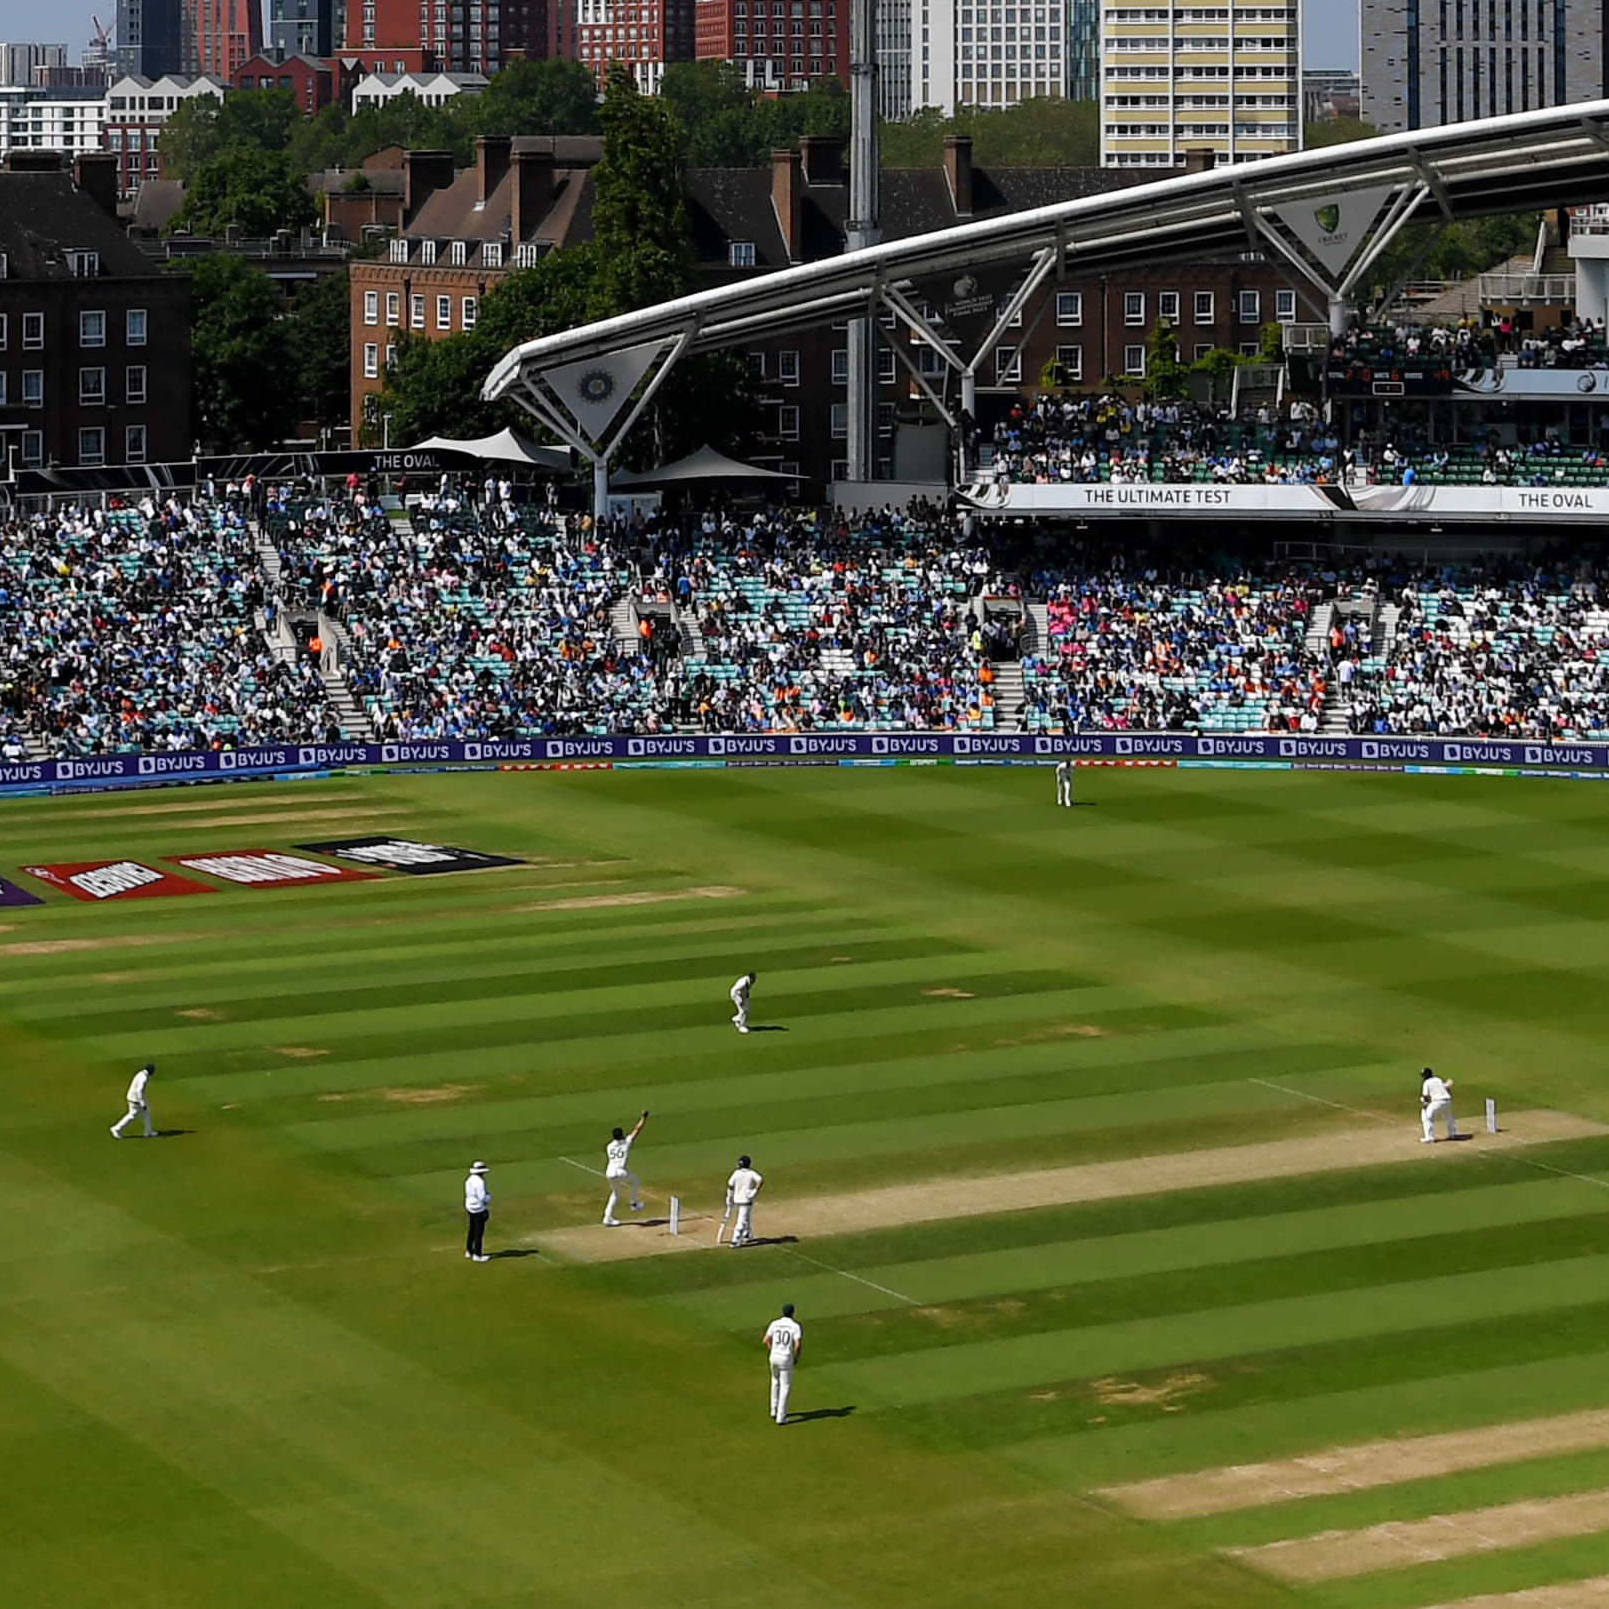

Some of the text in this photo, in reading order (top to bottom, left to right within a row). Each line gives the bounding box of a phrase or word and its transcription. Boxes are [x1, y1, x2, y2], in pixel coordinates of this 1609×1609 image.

[1391, 370, 1399, 380] 6
[374, 455, 440, 469] THE OVAL
[1085, 490, 1231, 504] THE ULTIMATE TEST
[1520, 493, 1593, 509] THE OVAL
[297, 627, 303, 638] 5
[482, 742, 532, 758] BYJU'S
[645, 739, 694, 755] BYJU'S
[646, 739, 695, 755] BYJU'S
[808, 738, 856, 754] BYJU'S
[890, 738, 939, 754] BYJU'S
[1053, 738, 1102, 754] BYJU'S
[1216, 739, 1264, 755] BYJU'S
[1298, 740, 1347, 757] BYJU'S
[1462, 744, 1511, 761] BYJU'S
[237, 752, 286, 767] BYJU'S
[318, 747, 367, 763] BYJU'S
[74, 760, 124, 777] BYJU'S
[610, 1147, 624, 1159] 56
[775, 1330, 790, 1345] 30
